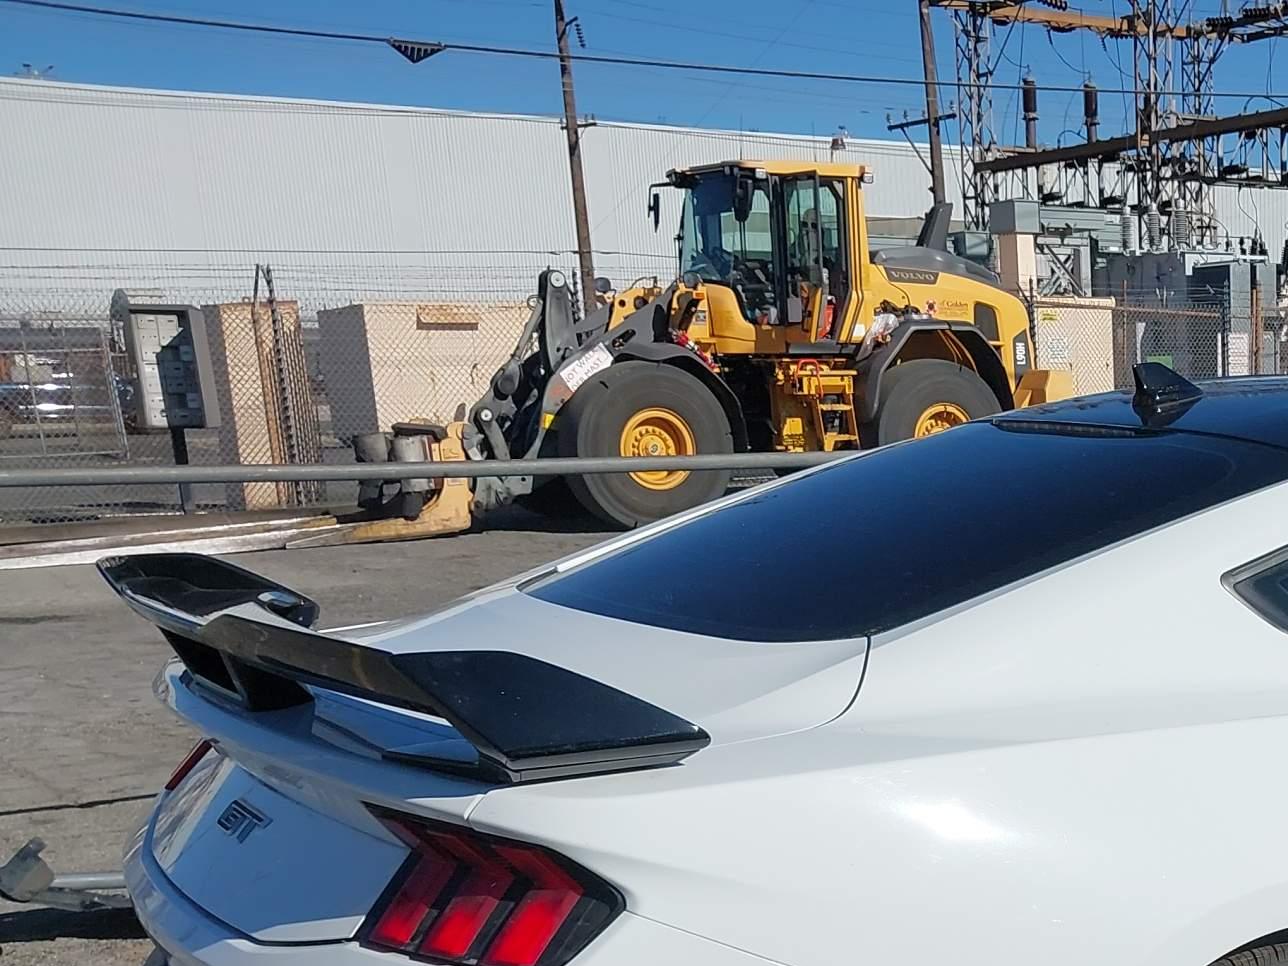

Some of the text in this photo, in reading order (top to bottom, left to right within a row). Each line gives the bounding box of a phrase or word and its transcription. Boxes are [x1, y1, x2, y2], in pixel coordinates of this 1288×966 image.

[891, 271, 935, 281] VOLVO
[1015, 342, 1026, 365] L90H
[216, 798, 273, 845] GT
